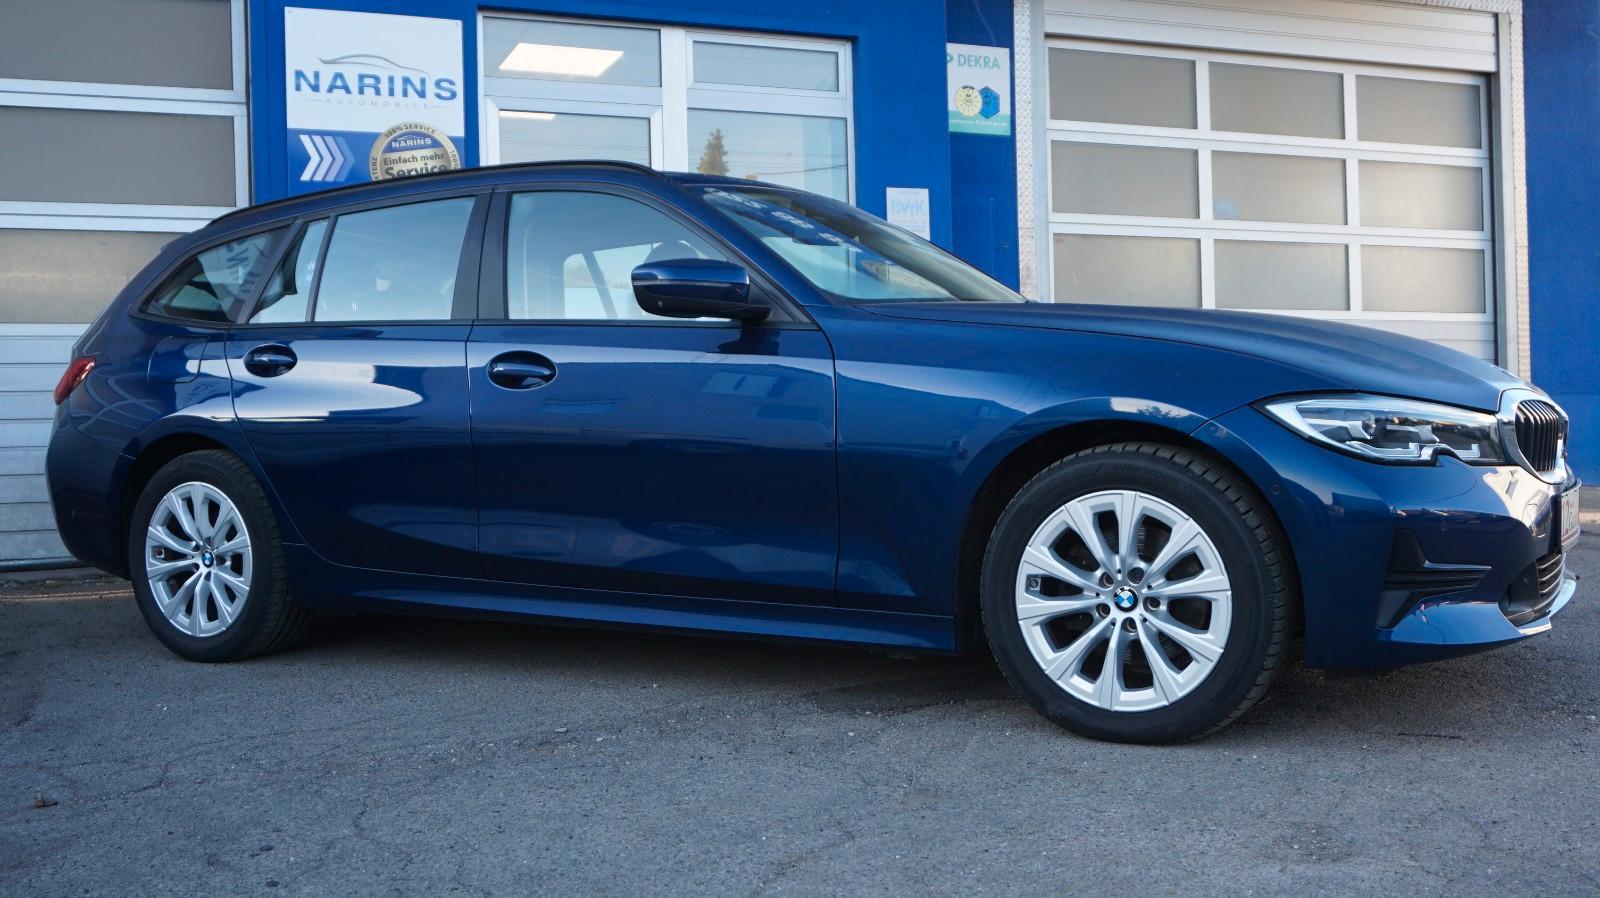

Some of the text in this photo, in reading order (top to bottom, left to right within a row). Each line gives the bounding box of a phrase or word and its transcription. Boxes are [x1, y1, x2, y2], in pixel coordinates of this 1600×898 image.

[957, 54, 1000, 69] DEKRA
[294, 69, 458, 101] NARINS
[404, 123, 436, 134] SERVICE
[391, 137, 432, 148] NARINS
[383, 151, 445, 166] Einfach mehr
